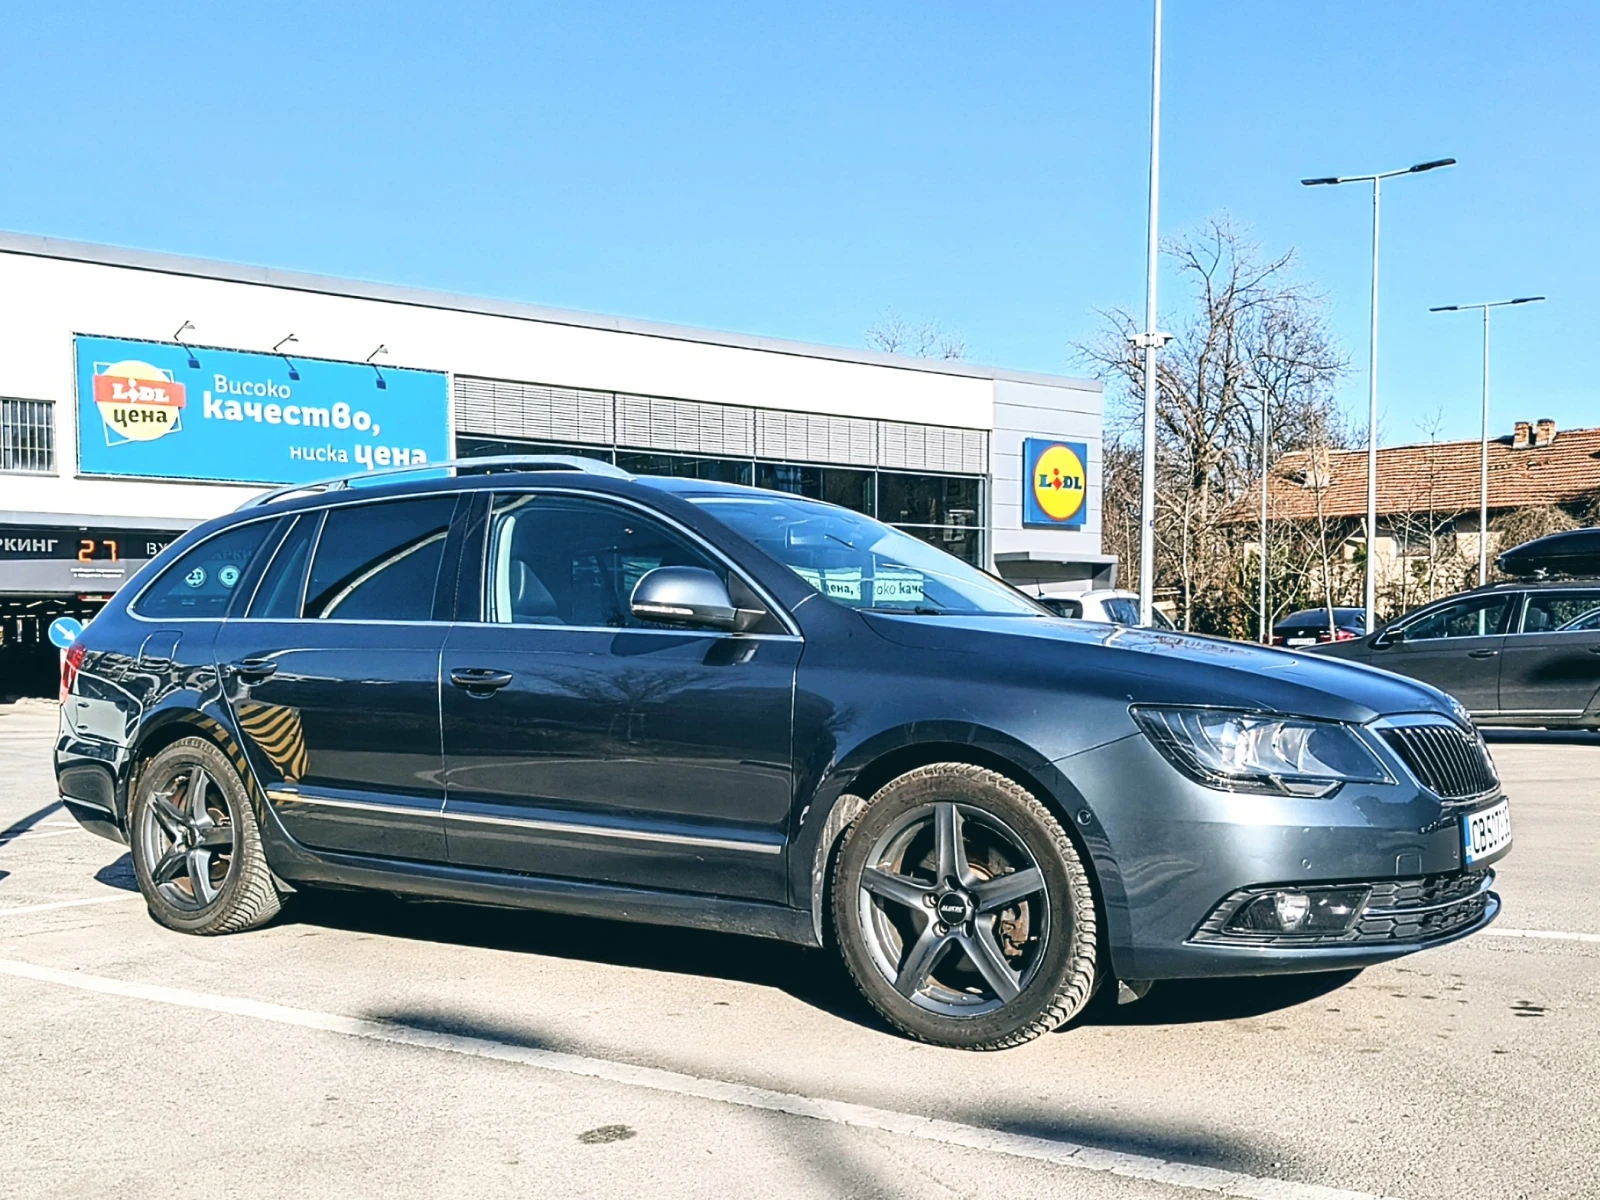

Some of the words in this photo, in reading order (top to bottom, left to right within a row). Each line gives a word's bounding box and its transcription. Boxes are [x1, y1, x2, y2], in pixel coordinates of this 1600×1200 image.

[112, 378, 170, 403] LIDL
[213, 374, 291, 399] Високо
[113, 408, 168, 427] цена
[203, 391, 381, 436] качество,
[289, 444, 349, 463] ниска
[354, 444, 428, 471] цена
[1038, 467, 1082, 491] LIDL
[78, 539, 117, 562] 27
